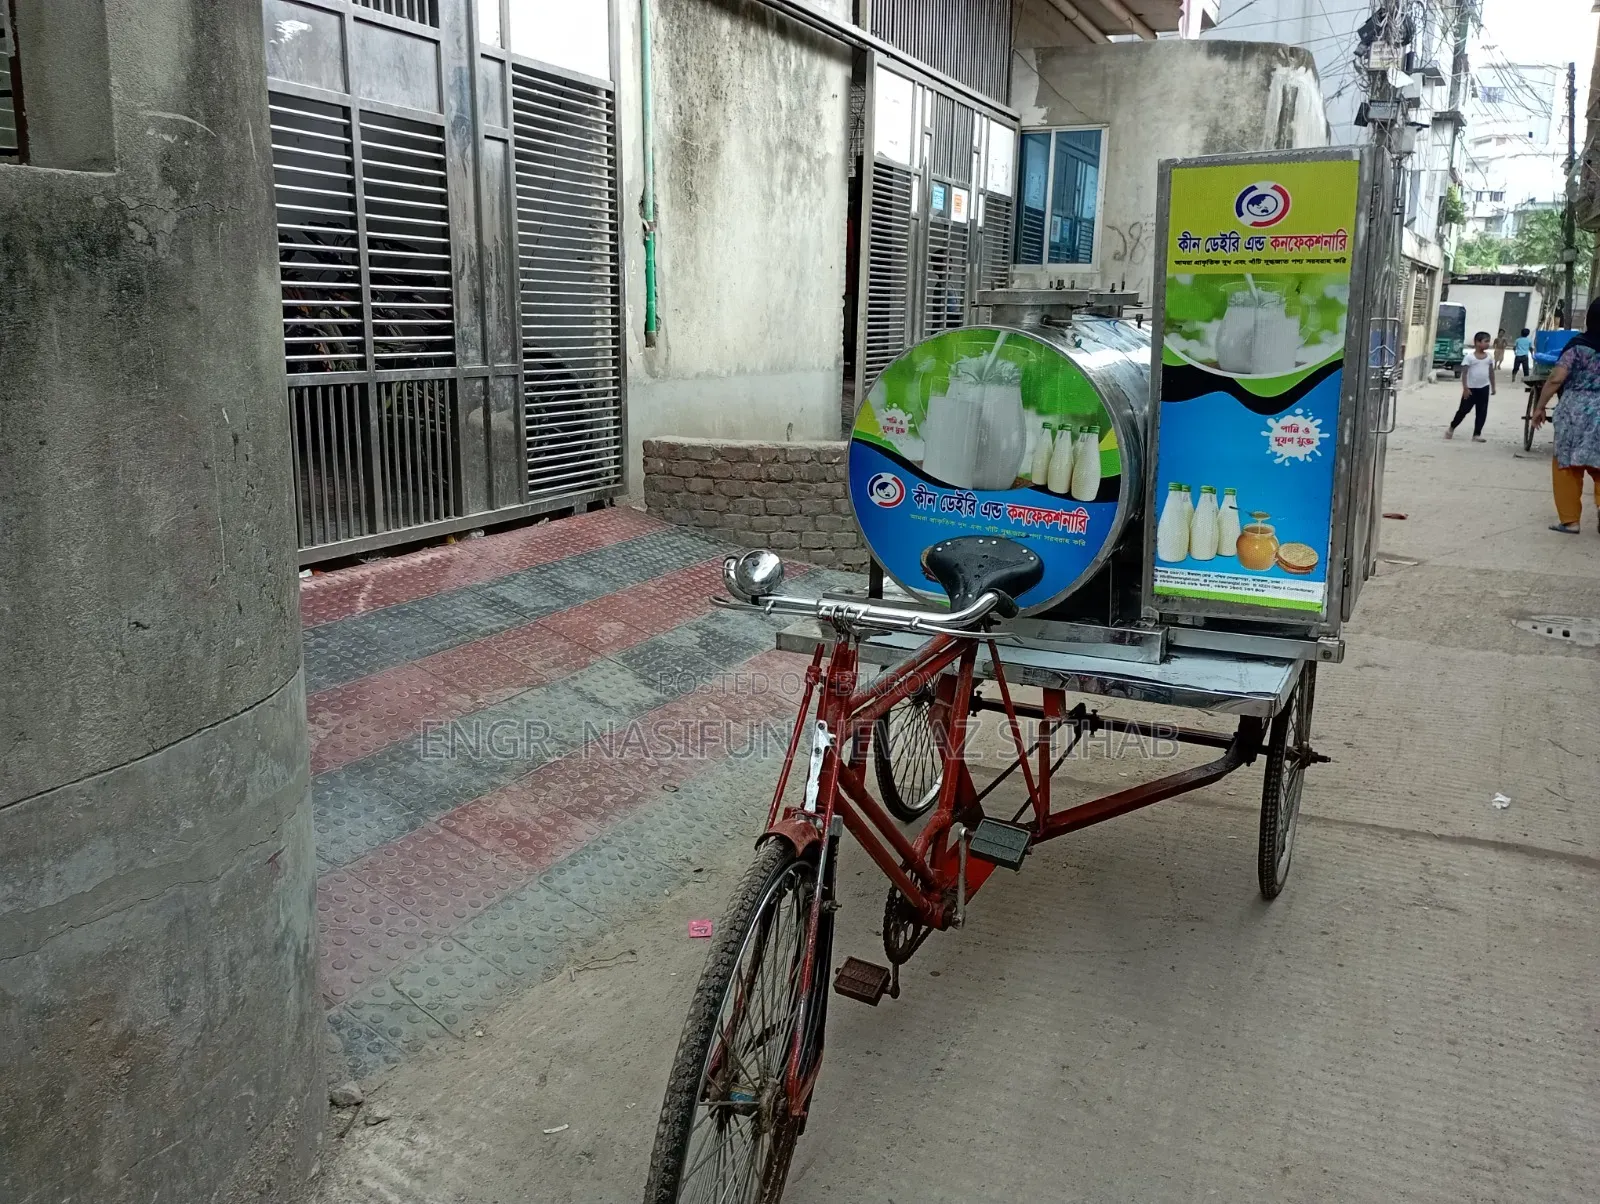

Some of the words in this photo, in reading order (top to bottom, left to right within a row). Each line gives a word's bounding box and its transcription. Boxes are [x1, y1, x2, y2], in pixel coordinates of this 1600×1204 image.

[1177, 231, 1202, 254] কীন
[1205, 230, 1241, 254] ডেইরি
[1244, 236, 1267, 252] এন্ড
[1270, 228, 1348, 252] কনফেকশনারি
[1281, 423, 1299, 434] পানি
[913, 484, 937, 512] কীন
[940, 489, 978, 518] ডেইরি
[980, 501, 1004, 521] এন্ড
[1006, 504, 1090, 534] কনফেকশনারি
